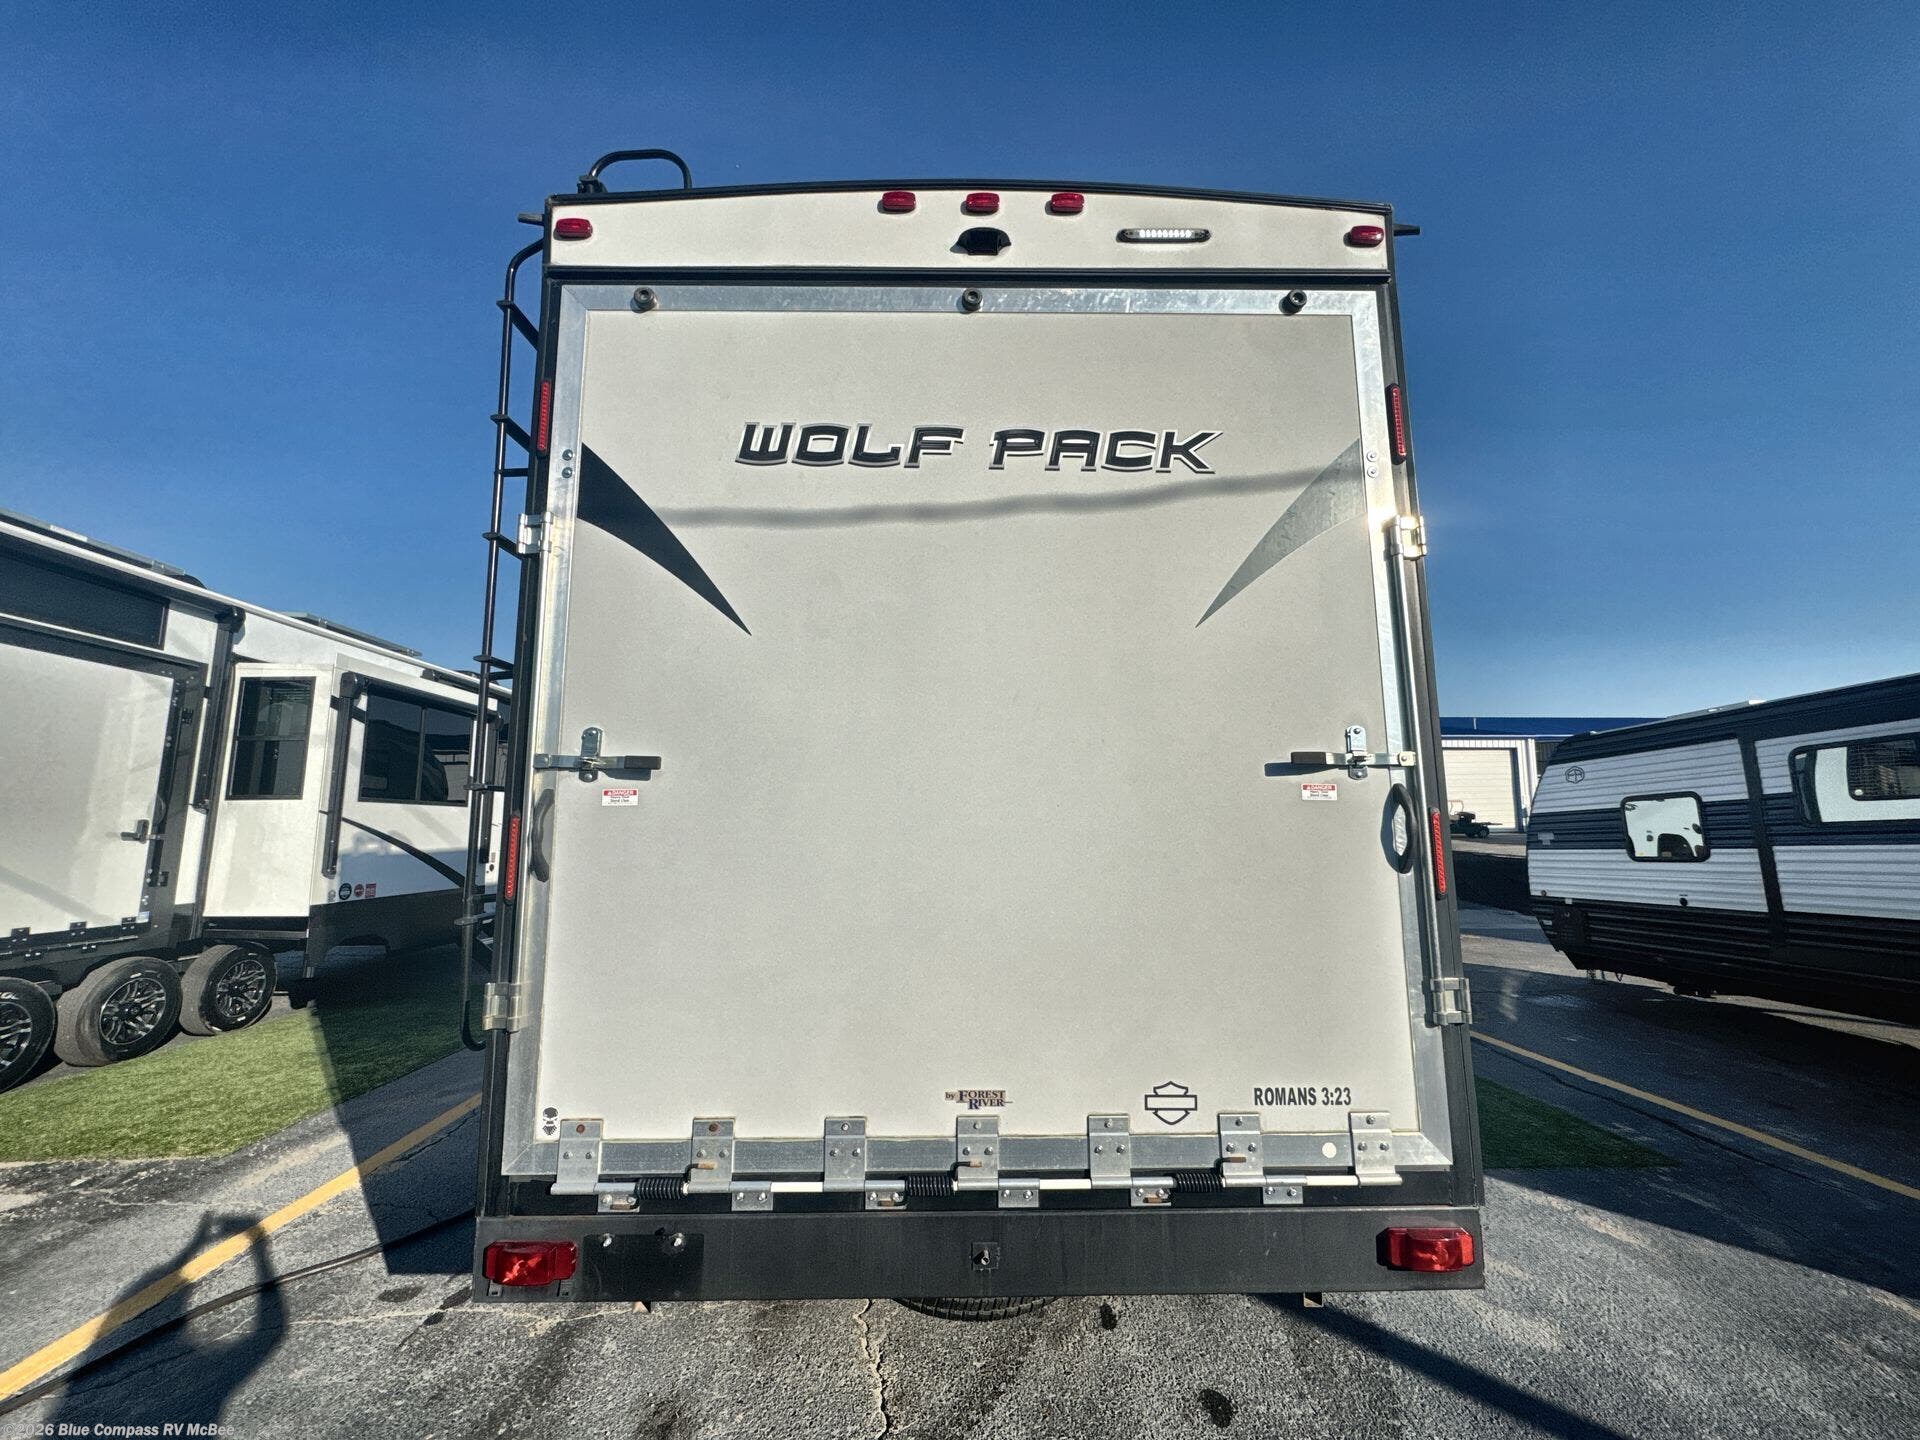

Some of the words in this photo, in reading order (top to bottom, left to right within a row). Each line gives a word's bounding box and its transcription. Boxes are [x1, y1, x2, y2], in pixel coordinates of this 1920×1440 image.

[735, 422, 965, 468] WOLF
[989, 428, 1224, 474] PACK
[945, 1092, 955, 1100] by
[956, 1090, 1006, 1103] FOREST
[968, 1099, 1004, 1110] RIVER
[1254, 1087, 1317, 1106] ROMANS
[1321, 1087, 1352, 1106] 3:23
